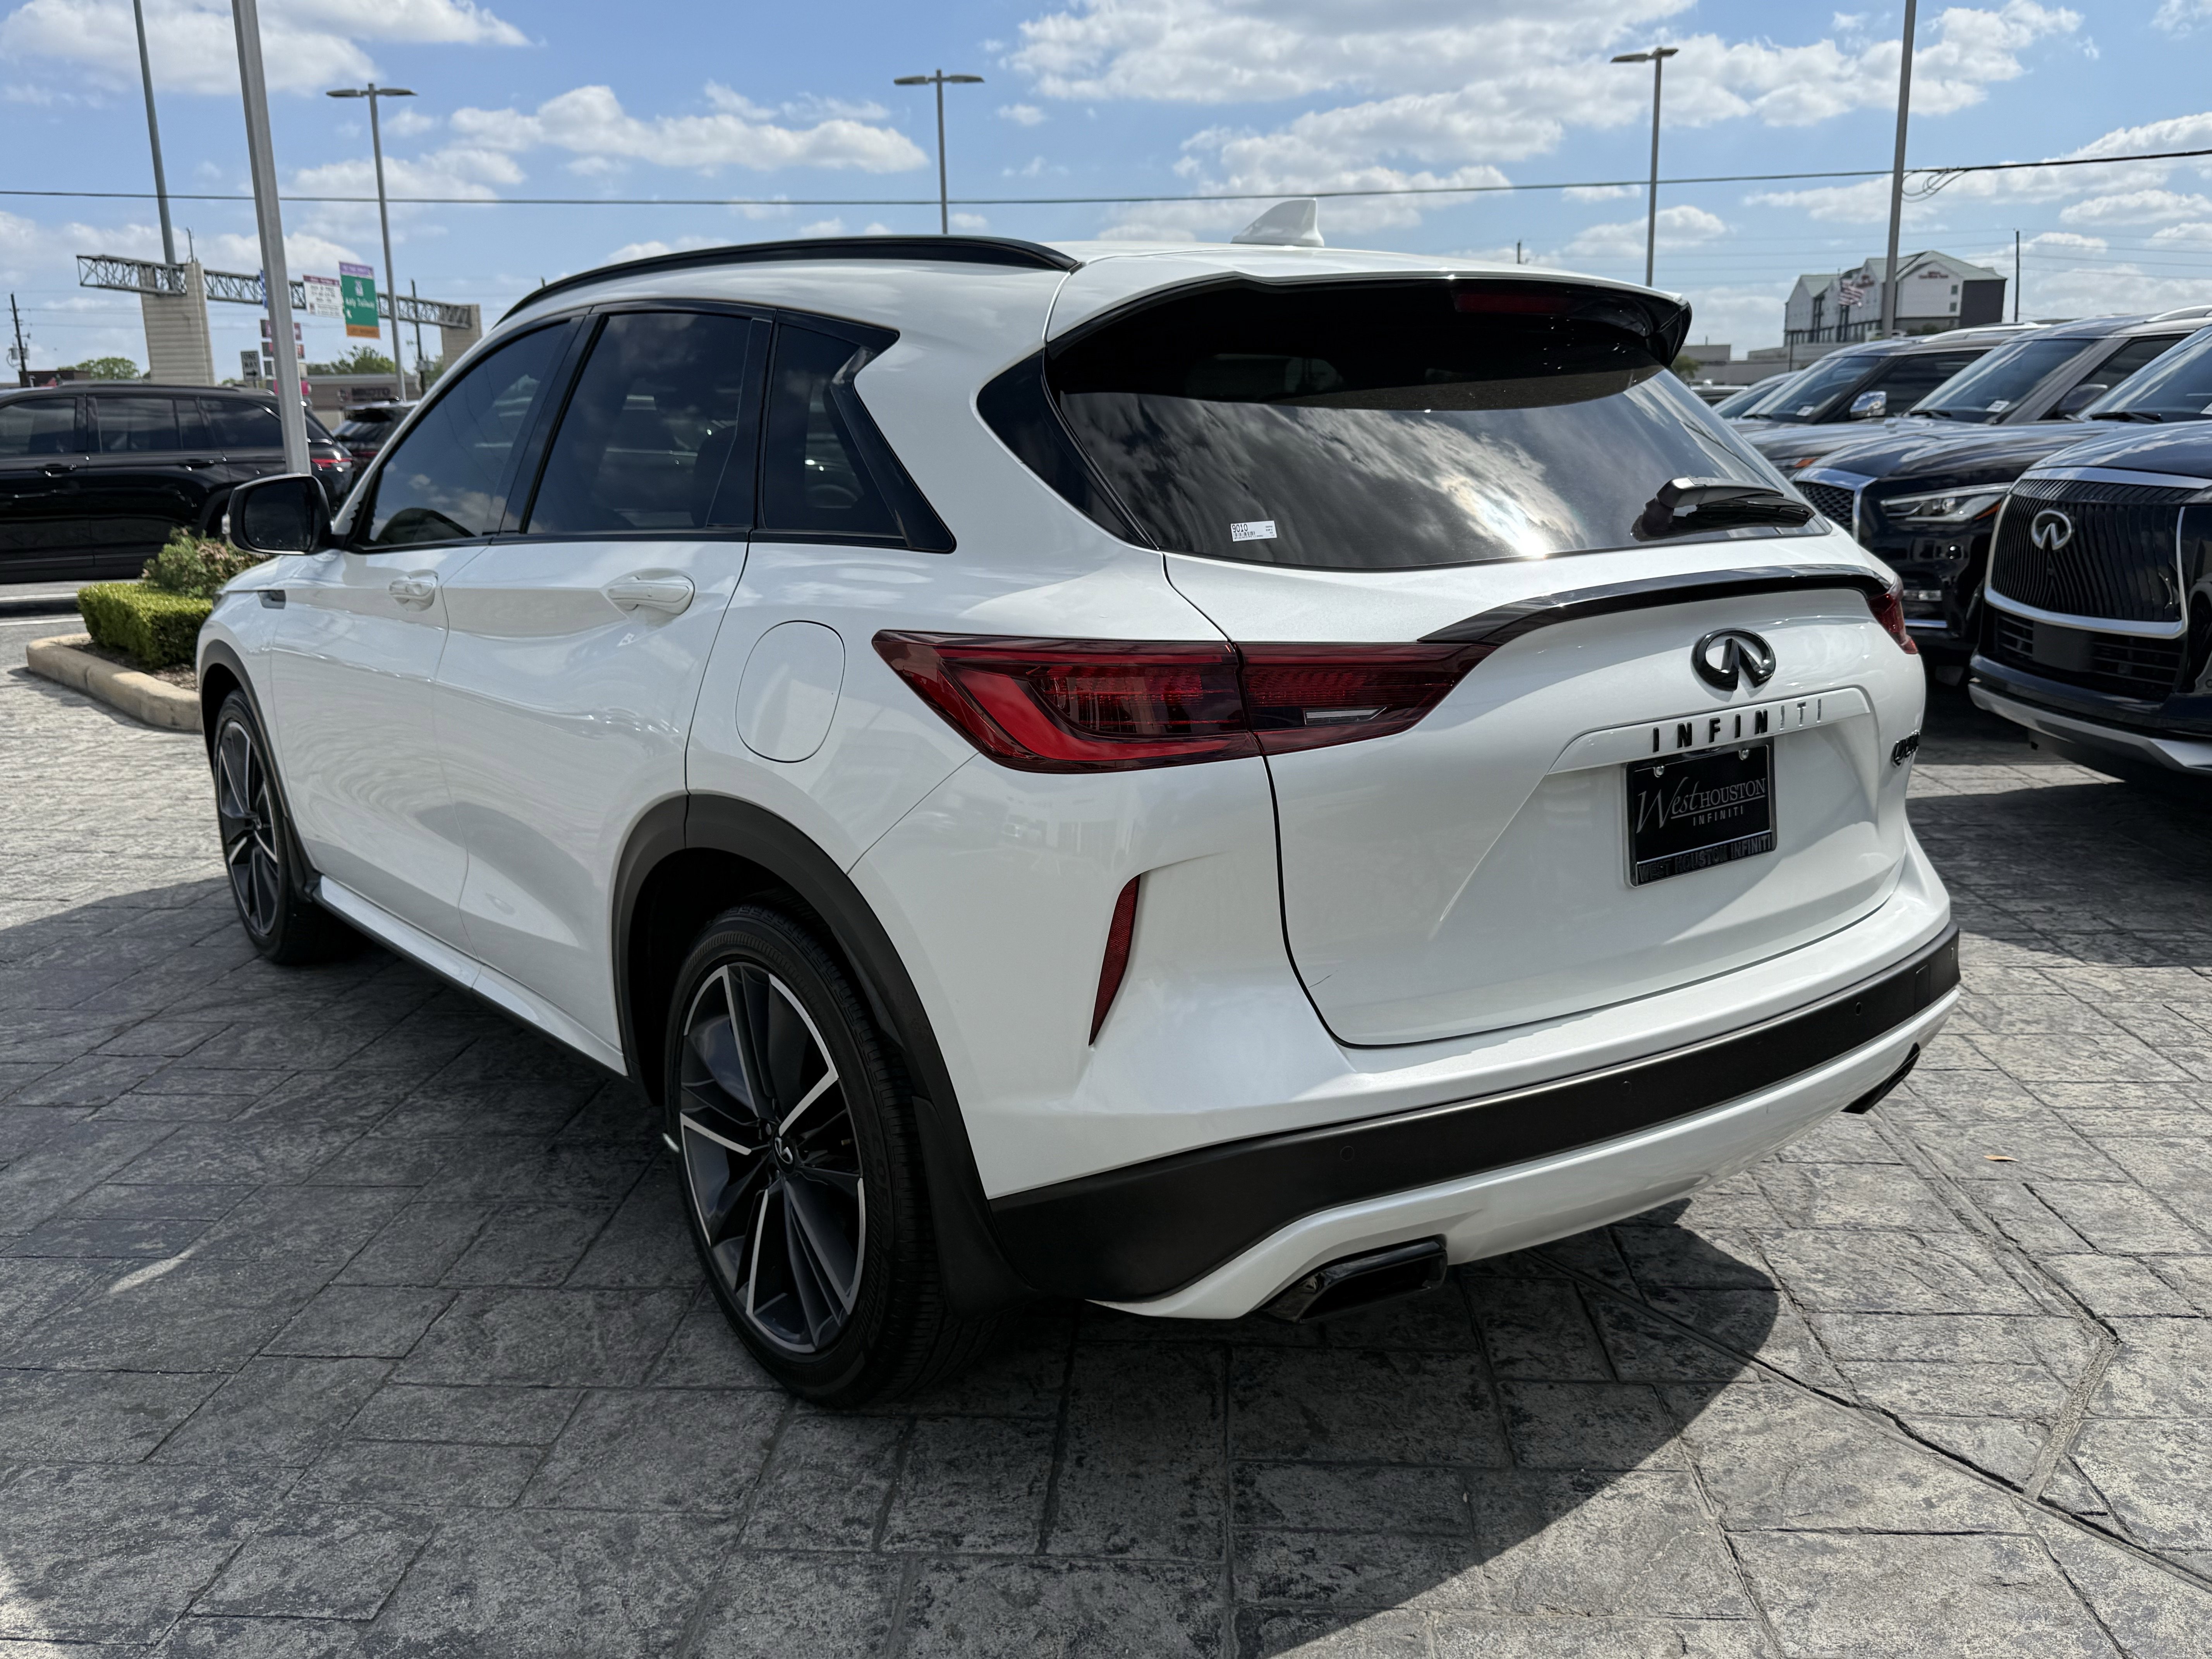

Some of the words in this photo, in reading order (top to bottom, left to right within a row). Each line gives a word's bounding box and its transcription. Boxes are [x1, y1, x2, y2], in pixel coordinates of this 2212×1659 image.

[1232, 524, 1248, 533] 9010
[1653, 699, 1822, 753] INFINITI
[1636, 776, 1700, 834] West
[1699, 778, 1766, 808] HOUSTON
[1693, 805, 1743, 826] INFINITI
[1638, 859, 1672, 883] WEST
[1674, 845, 1728, 874] HOUSTON
[1730, 834, 1771, 859] INFINITI
